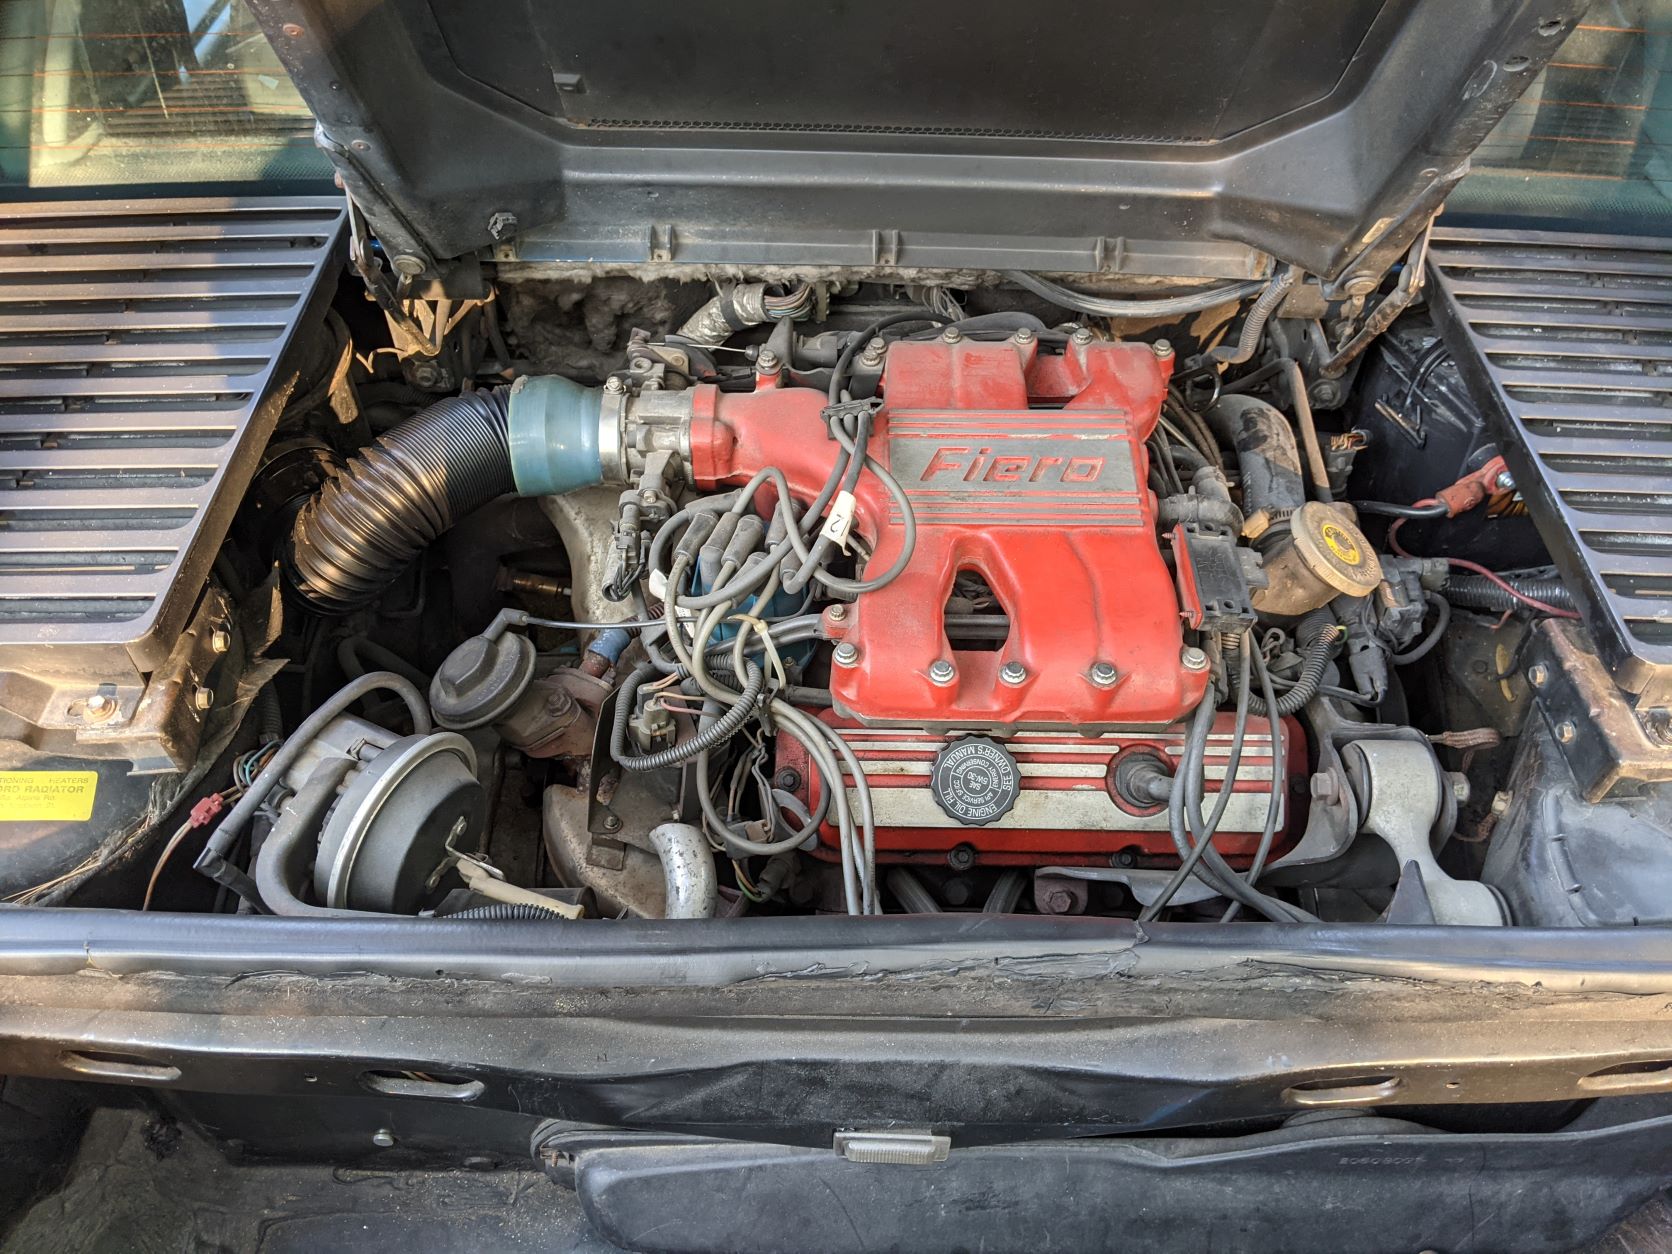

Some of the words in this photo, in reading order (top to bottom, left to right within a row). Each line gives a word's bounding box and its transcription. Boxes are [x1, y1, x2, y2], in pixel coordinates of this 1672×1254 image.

[920, 446, 1107, 483] Fiero
[944, 745, 975, 768] MANUAL
[977, 745, 1010, 774] OWNER'S
[955, 758, 990, 774] CONSERVING
[967, 771, 989, 785] 5W-30
[988, 766, 999, 788] ENERGY
[1003, 774, 1012, 791] SEE
[24, 785, 84, 793] RADIATOR
[968, 780, 982, 791] SAE
[942, 787, 956, 803] FILL
[961, 795, 984, 804] SERVICE
[984, 791, 994, 802] API
[953, 800, 966, 814] OIL
[967, 803, 998, 817] ENGINE
